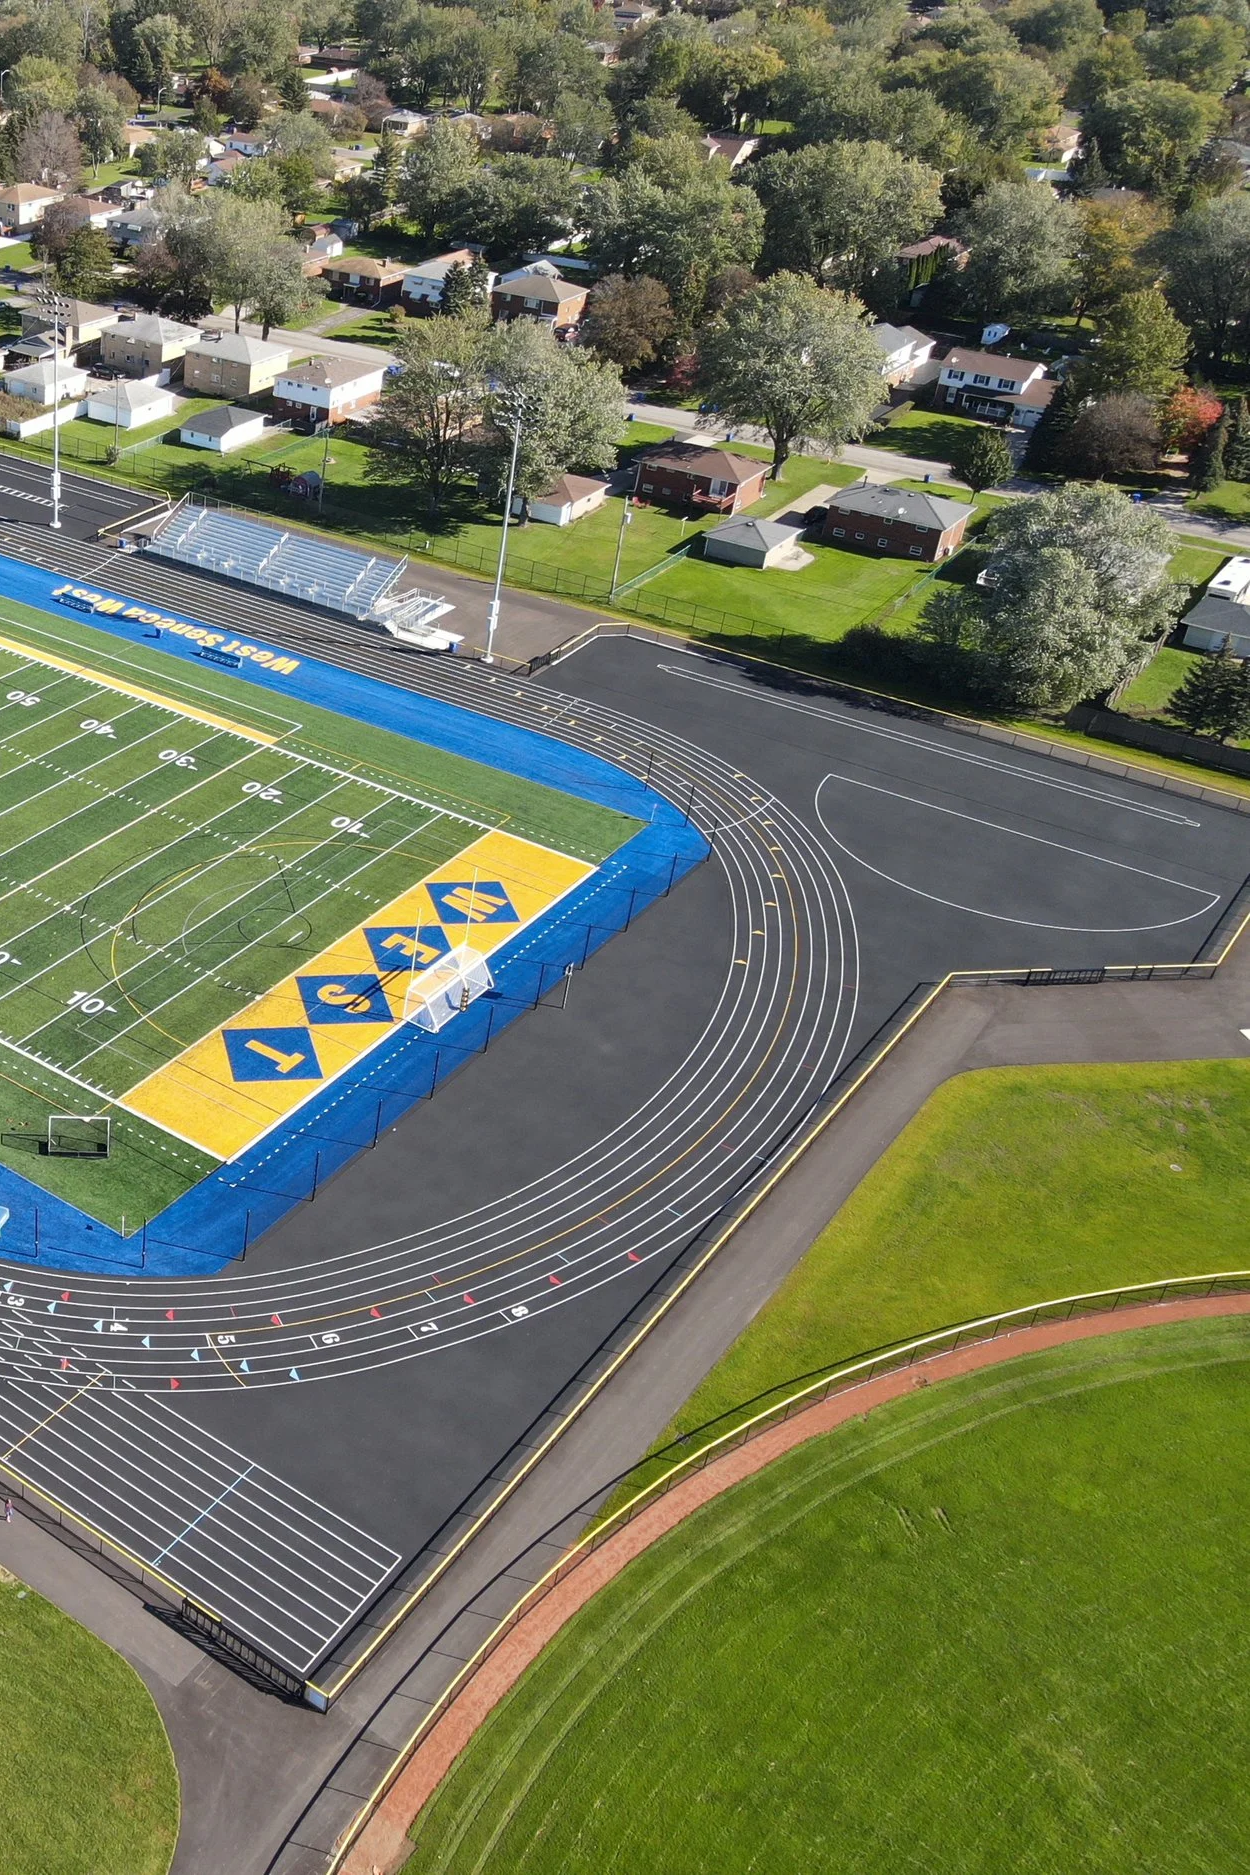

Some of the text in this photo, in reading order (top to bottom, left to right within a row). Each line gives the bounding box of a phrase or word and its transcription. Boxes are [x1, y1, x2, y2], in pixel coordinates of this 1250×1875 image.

[122, 606, 228, 648] Seneca
[221, 639, 301, 676] West
[5, 690, 41, 707] 50
[79, 719, 113, 737] 40
[157, 749, 195, 767] 30
[241, 781, 283, 800] 20
[330, 816, 364, 835] 10
[66, 990, 106, 1015] 10
[7, 1295, 25, 1307] 3
[510, 1305, 529, 1318] 8
[109, 1322, 129, 1333] 4
[420, 1321, 439, 1333] 7
[217, 1334, 236, 1345] 5
